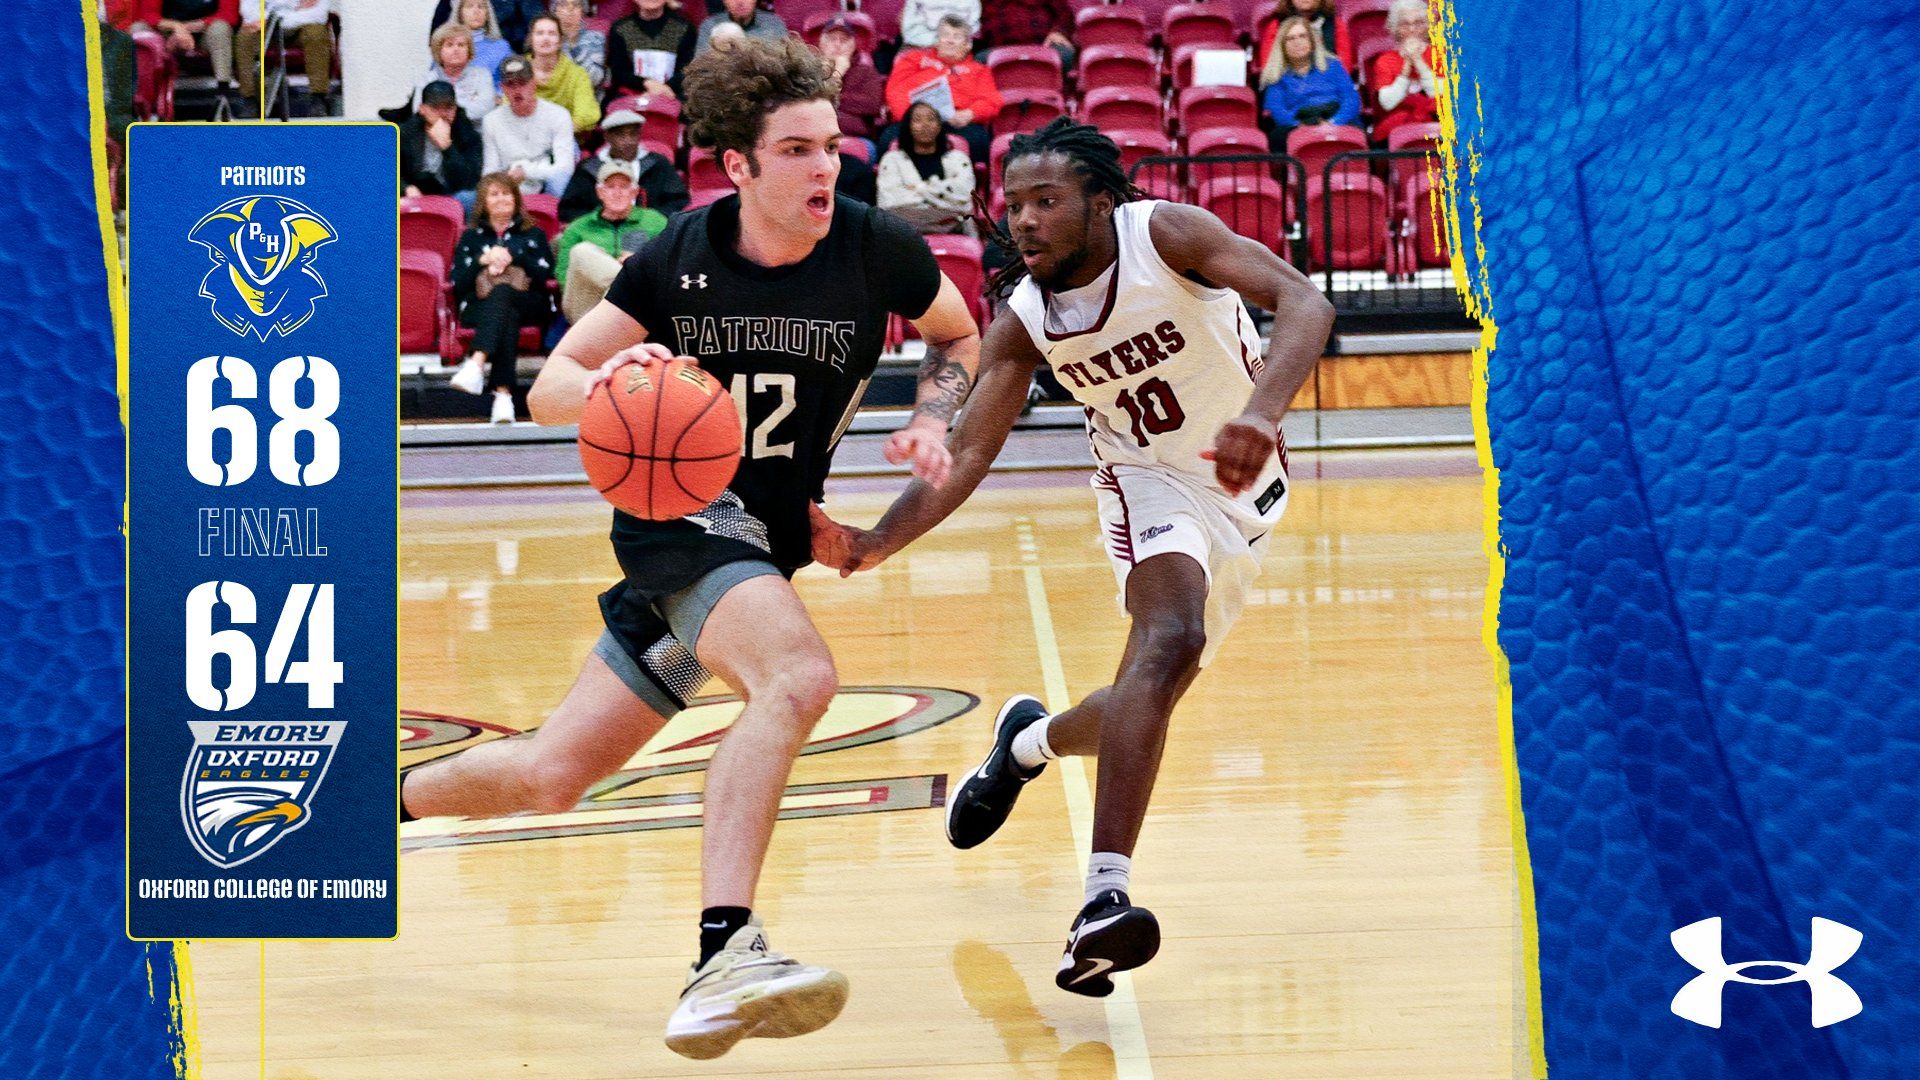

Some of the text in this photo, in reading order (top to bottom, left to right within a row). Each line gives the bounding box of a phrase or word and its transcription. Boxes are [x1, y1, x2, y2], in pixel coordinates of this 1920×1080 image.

[672, 316, 855, 373] PATRIOTS
[1057, 320, 1186, 388] FLYERS
[1114, 376, 1186, 448] 10
